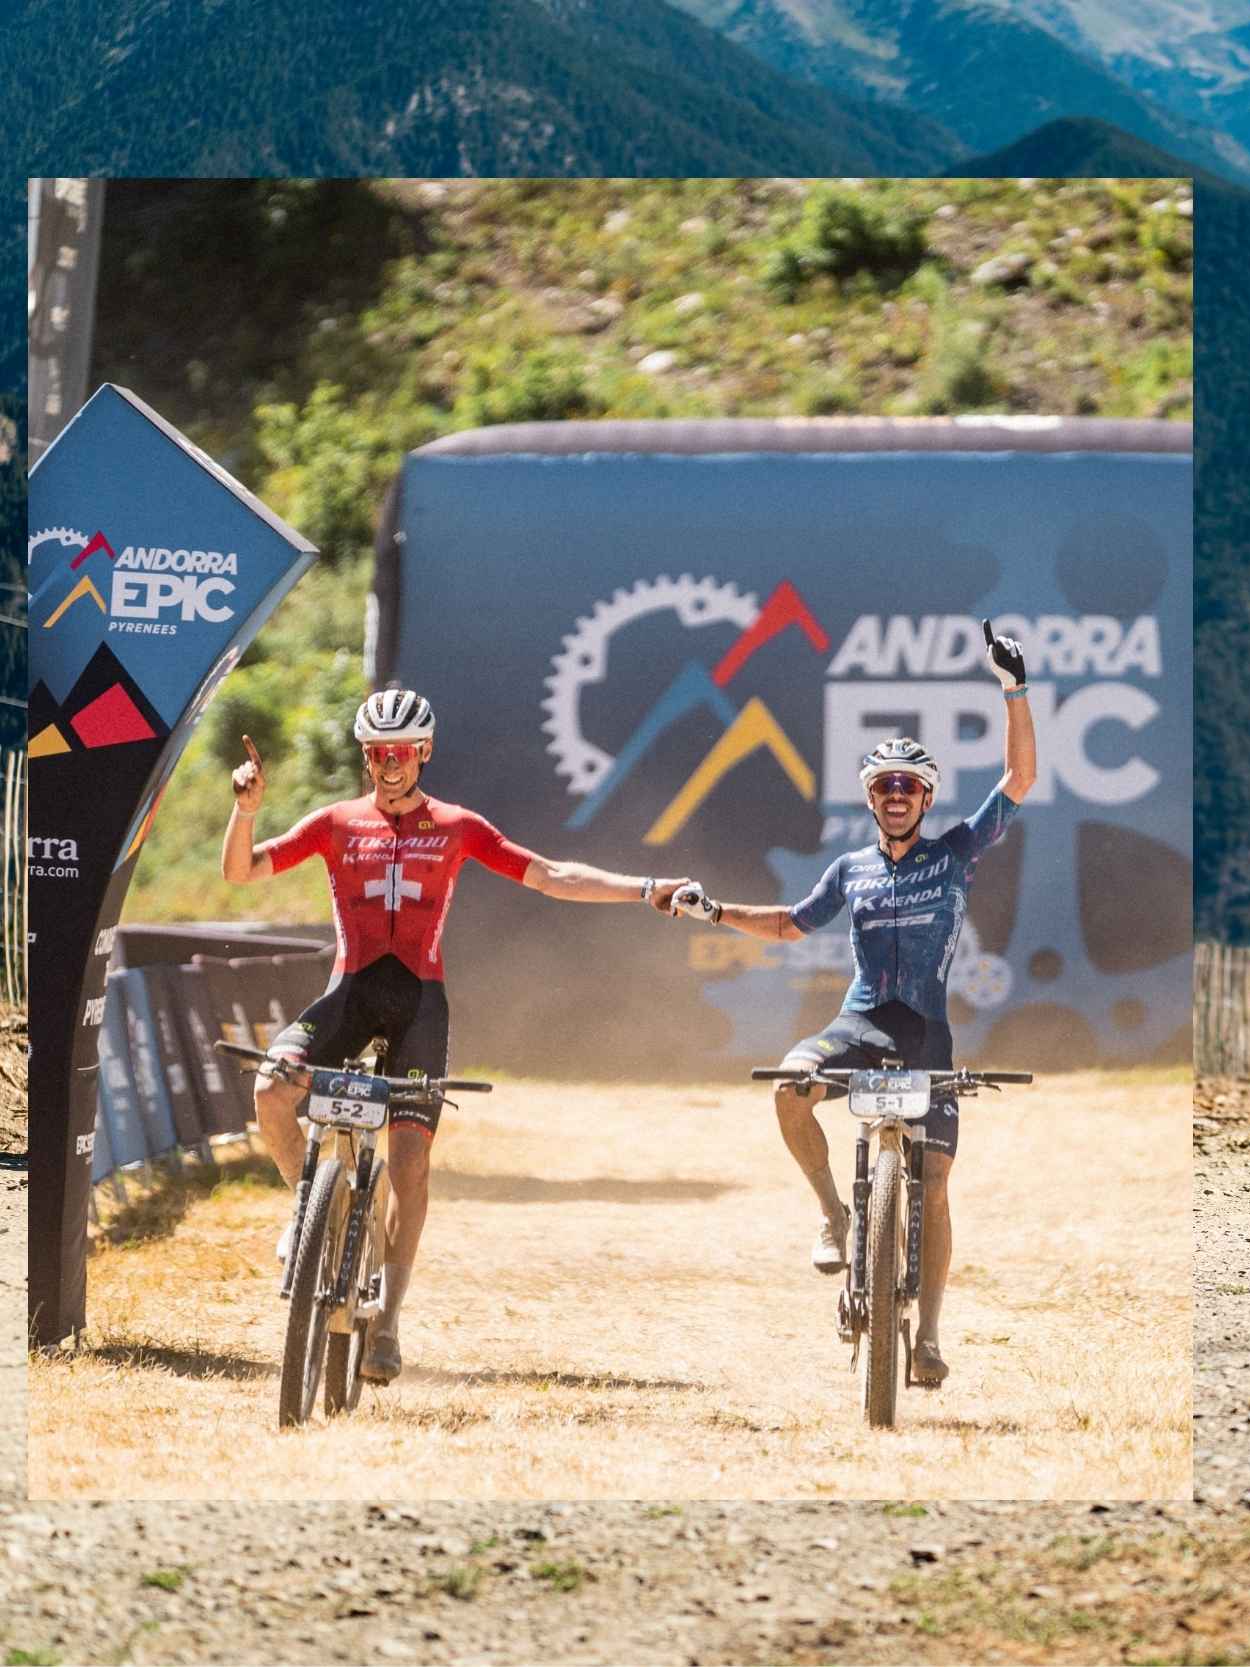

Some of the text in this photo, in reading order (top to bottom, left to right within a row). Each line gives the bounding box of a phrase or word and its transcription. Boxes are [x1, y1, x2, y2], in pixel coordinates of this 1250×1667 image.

[114, 545, 239, 576] ANDORRA
[110, 570, 236, 623] EPIC
[107, 621, 178, 636] PYRENEES
[844, 854, 950, 895] TORPADO
[880, 885, 943, 908] KENDA
[330, 1100, 364, 1119] 5-2
[875, 1096, 904, 1110] 5-1
[909, 1200, 922, 1274] MANITOU
